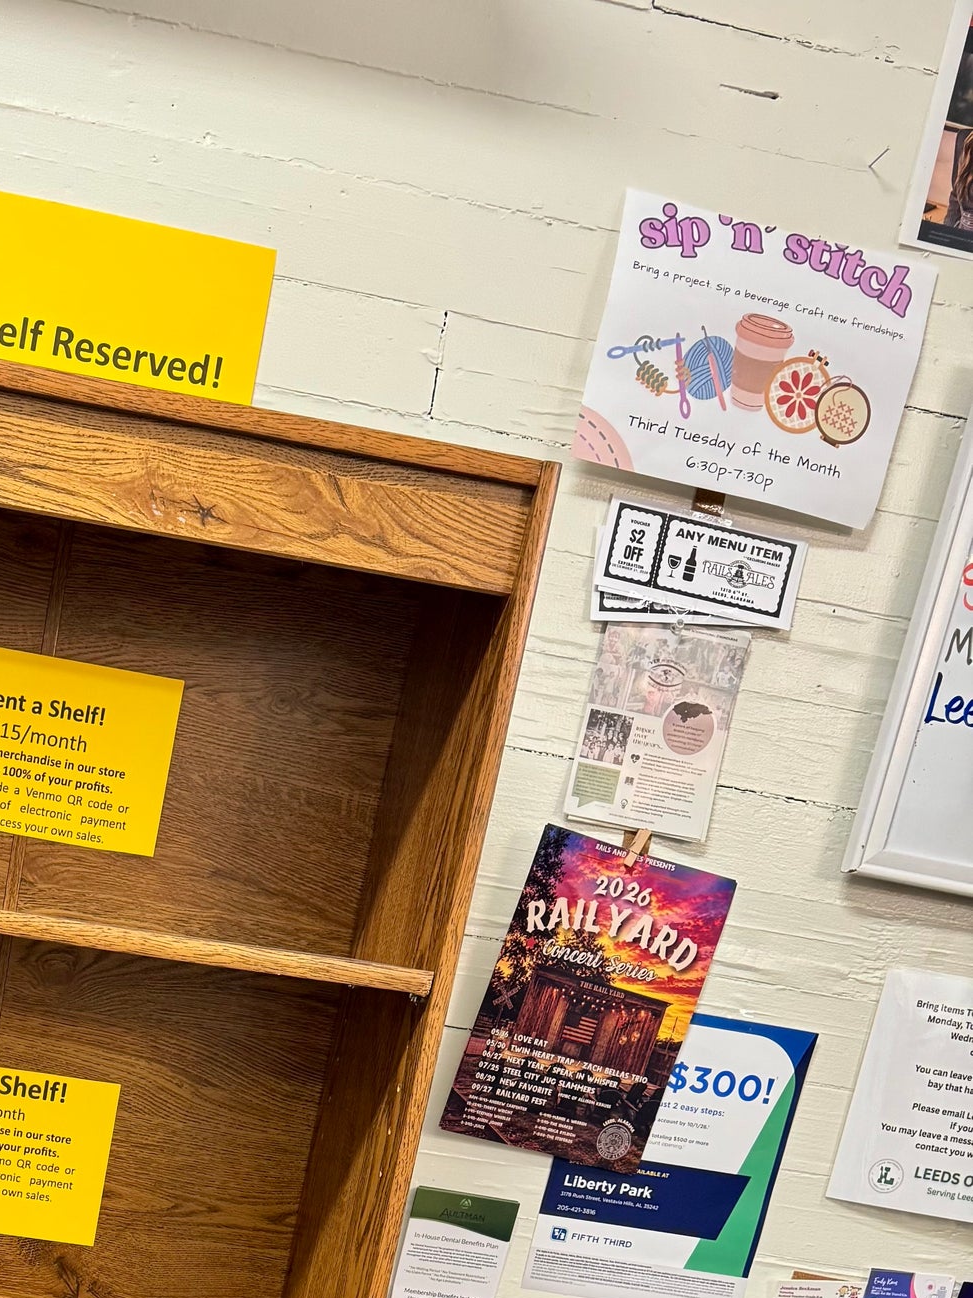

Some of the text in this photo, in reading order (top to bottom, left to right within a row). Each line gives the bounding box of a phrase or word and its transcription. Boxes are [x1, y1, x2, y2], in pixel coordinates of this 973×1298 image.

[639, 202, 711, 258] sip
[783, 233, 912, 318] stitch
[631, 259, 660, 280] Bring
[714, 282, 731, 297] Sip
[733, 288, 741, 296] a
[794, 302, 824, 318] Craft
[826, 313, 848, 324] new
[51, 325, 224, 389] Reserved!
[628, 414, 841, 479] Third Tuesday of the Month
[684, 455, 774, 492] 6:30p-7:30p
[629, 528, 646, 546] $2
[675, 527, 784, 562] ANY MENU ITEM
[623, 544, 644, 563] OFF
[702, 560, 776, 590] RAILS ALES
[30, 700, 43, 715] a
[47, 698, 106, 726] Shelf!
[1, 765, 32, 780] 100%
[33, 771, 47, 782] of
[47, 774, 73, 787] your
[73, 779, 113, 794] profits.
[63, 758, 75, 771] in
[76, 763, 96, 774] our
[97, 766, 126, 780] store
[12, 786, 20, 795] a
[25, 786, 62, 803] Venmo
[66, 793, 83, 806] QR
[86, 799, 113, 812] code
[116, 804, 130, 814] or
[18, 802, 72, 821] electronic
[79, 814, 126, 831] payment
[23, 822, 49, 834] your
[49, 826, 73, 838] own
[74, 830, 104, 844] sales.
[593, 875, 653, 907] 2026
[526, 896, 698, 972] RAILYARD
[542, 938, 657, 982] Concert Series
[915, 998, 940, 1013] Bring
[926, 1014, 963, 1030] Monday,
[513, 1033, 549, 1048] LOVE RAT
[499, 1077, 553, 1096] NEW FAVORITE
[667, 1061, 776, 1105] $300!
[495, 1088, 530, 1102] RAILYARD
[530, 1095, 548, 1107] FEST
[679, 1103, 725, 1117] easy steps:
[911, 1101, 966, 1119] Please email
[880, 1121, 942, 1141] You may leave
[563, 1173, 653, 1199] Liberty Park
[913, 1165, 961, 1185] LEEDS
[570, 1231, 633, 1248] FIFTH THIRD
